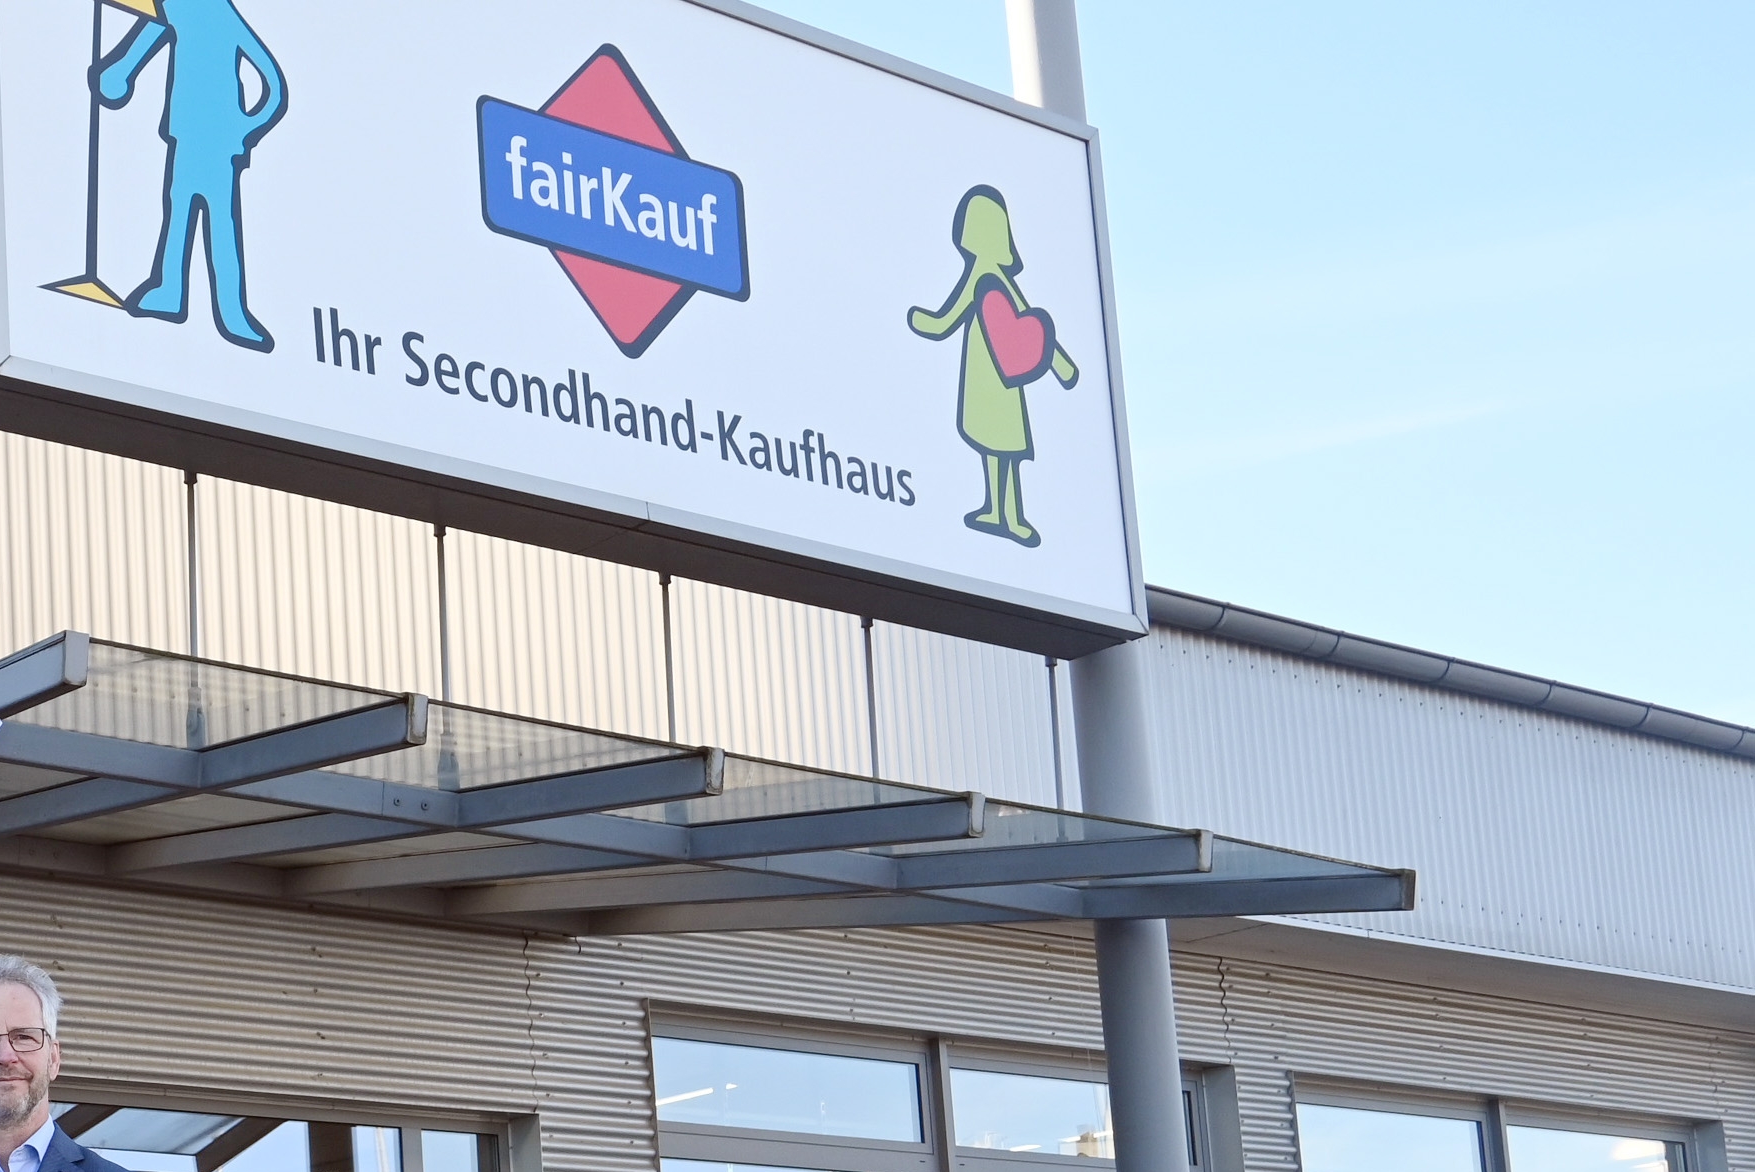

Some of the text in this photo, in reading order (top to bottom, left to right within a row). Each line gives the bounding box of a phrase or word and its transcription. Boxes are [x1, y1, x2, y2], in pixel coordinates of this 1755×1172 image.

[505, 136, 718, 256] fairKauf
[313, 307, 917, 508] Ihr Secondhand-Kaufhaus
